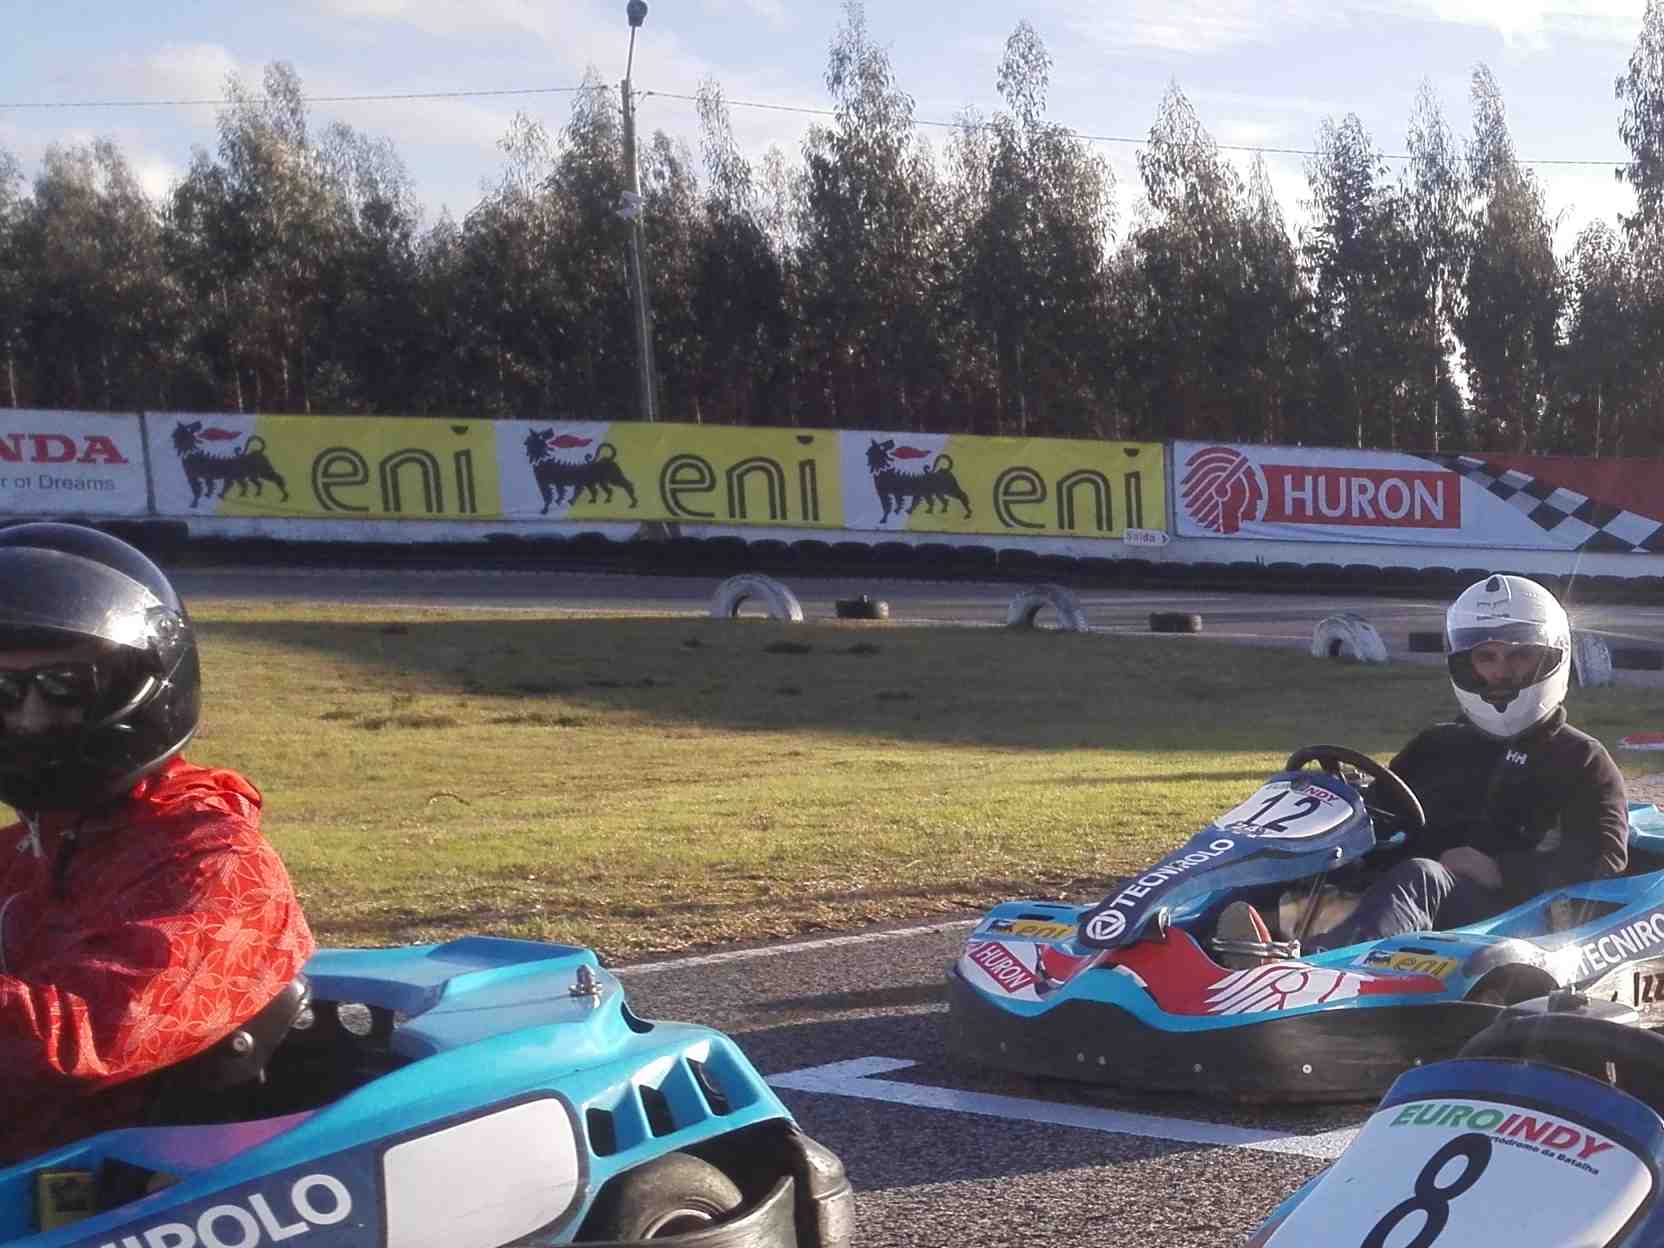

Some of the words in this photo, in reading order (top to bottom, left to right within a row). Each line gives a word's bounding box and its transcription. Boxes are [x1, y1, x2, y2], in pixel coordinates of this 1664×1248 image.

[39, 474, 116, 491] Dreams
[310, 424, 478, 514] eni
[658, 434, 820, 522] eni
[992, 447, 1142, 532] eni
[1284, 473, 1446, 521] HURON
[1249, 789, 1321, 833] 12
[980, 945, 1033, 989] HURON
[1389, 1103, 1615, 1159] EUROINDY
